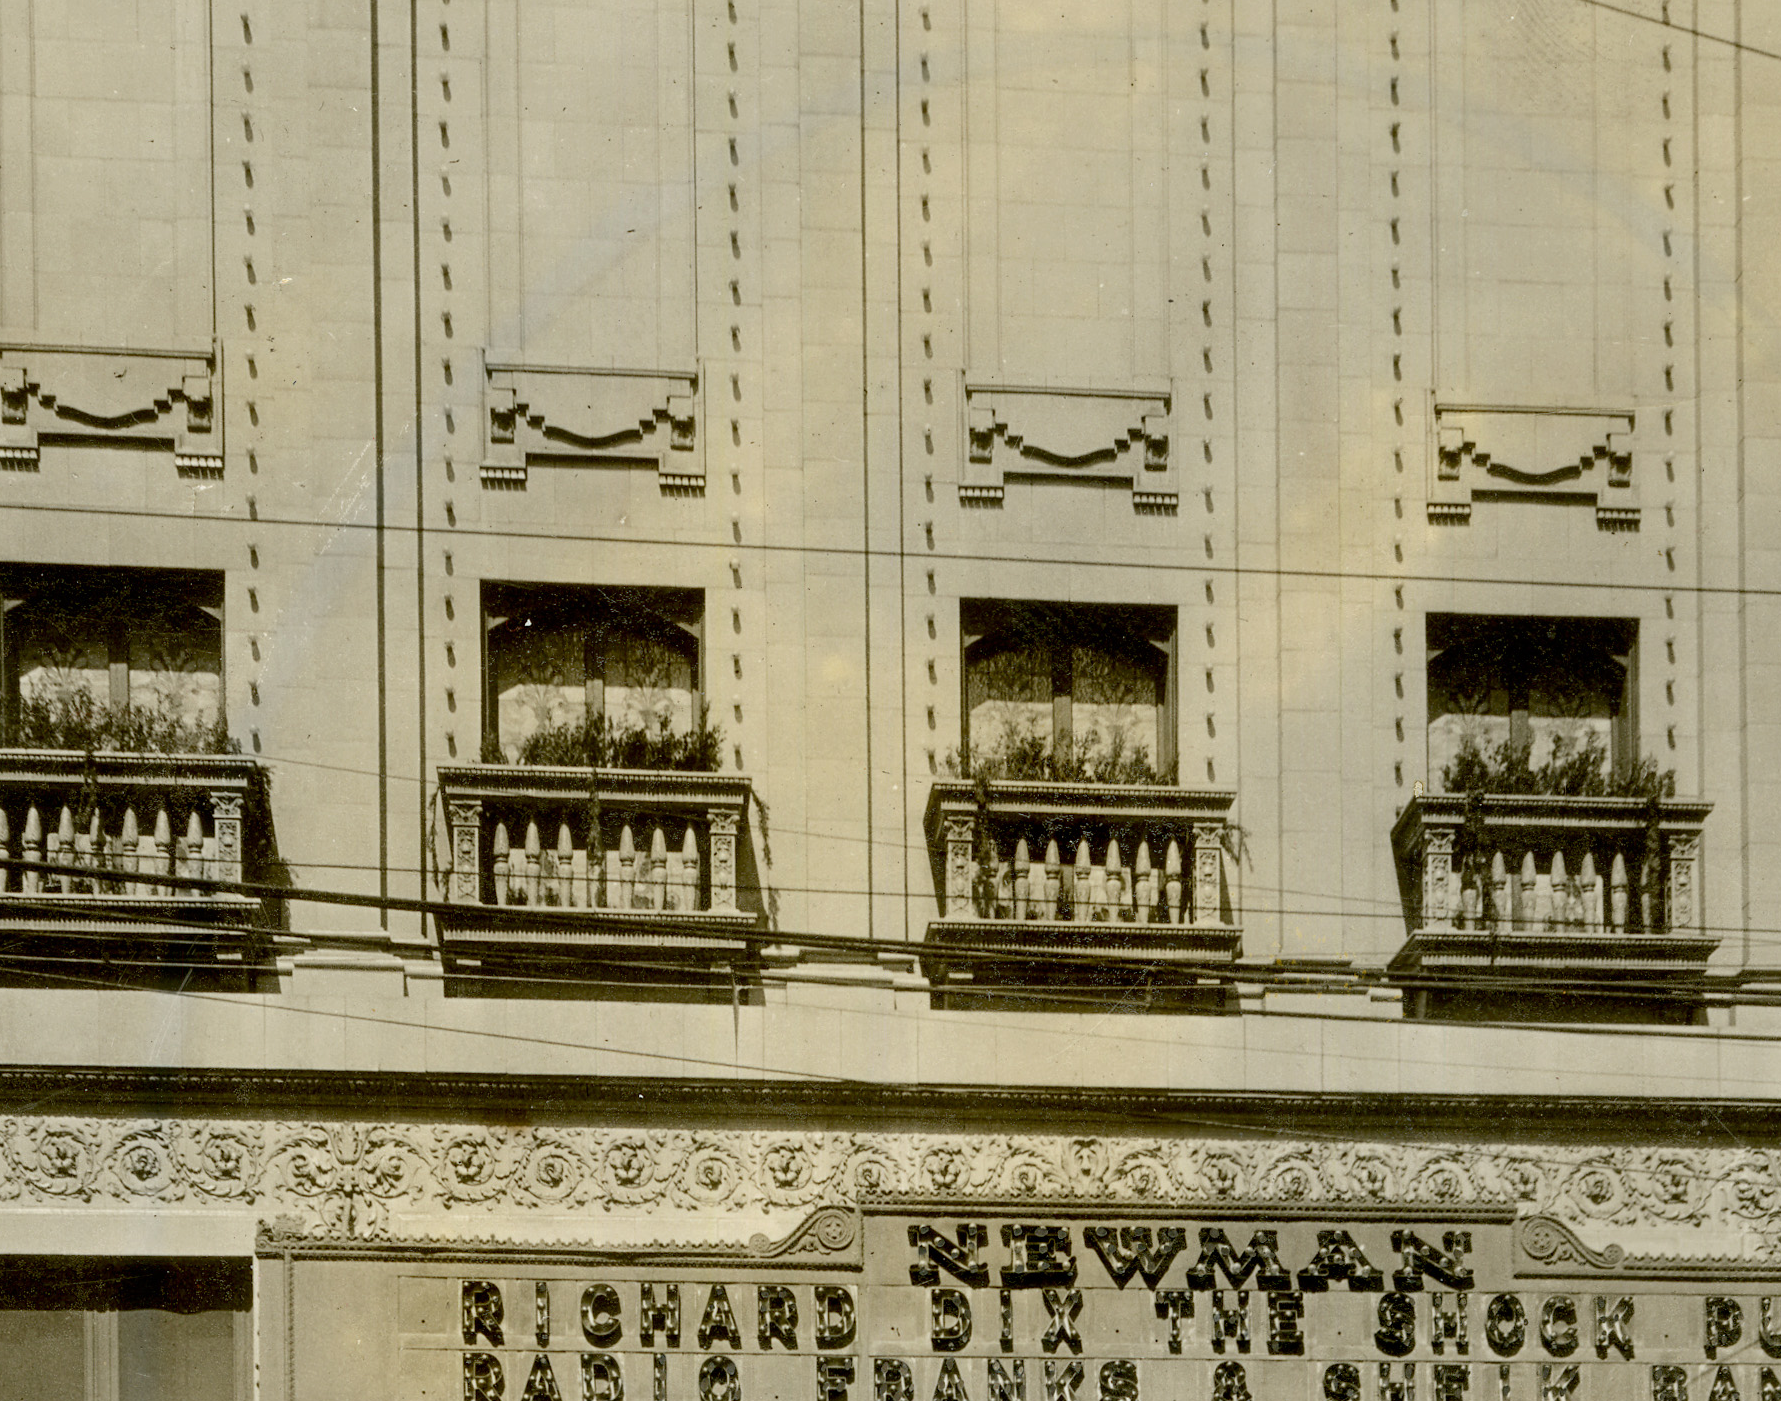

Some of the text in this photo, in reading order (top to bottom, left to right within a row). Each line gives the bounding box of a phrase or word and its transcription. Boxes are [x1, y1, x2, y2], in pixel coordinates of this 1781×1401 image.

[908, 1223, 1474, 1291] NEWMAN
[461, 1279, 858, 1350] RICHARD
[930, 1288, 1085, 1354] DIX
[1155, 1290, 1305, 1355] THE
[1374, 1291, 1636, 1359] SHOCK
